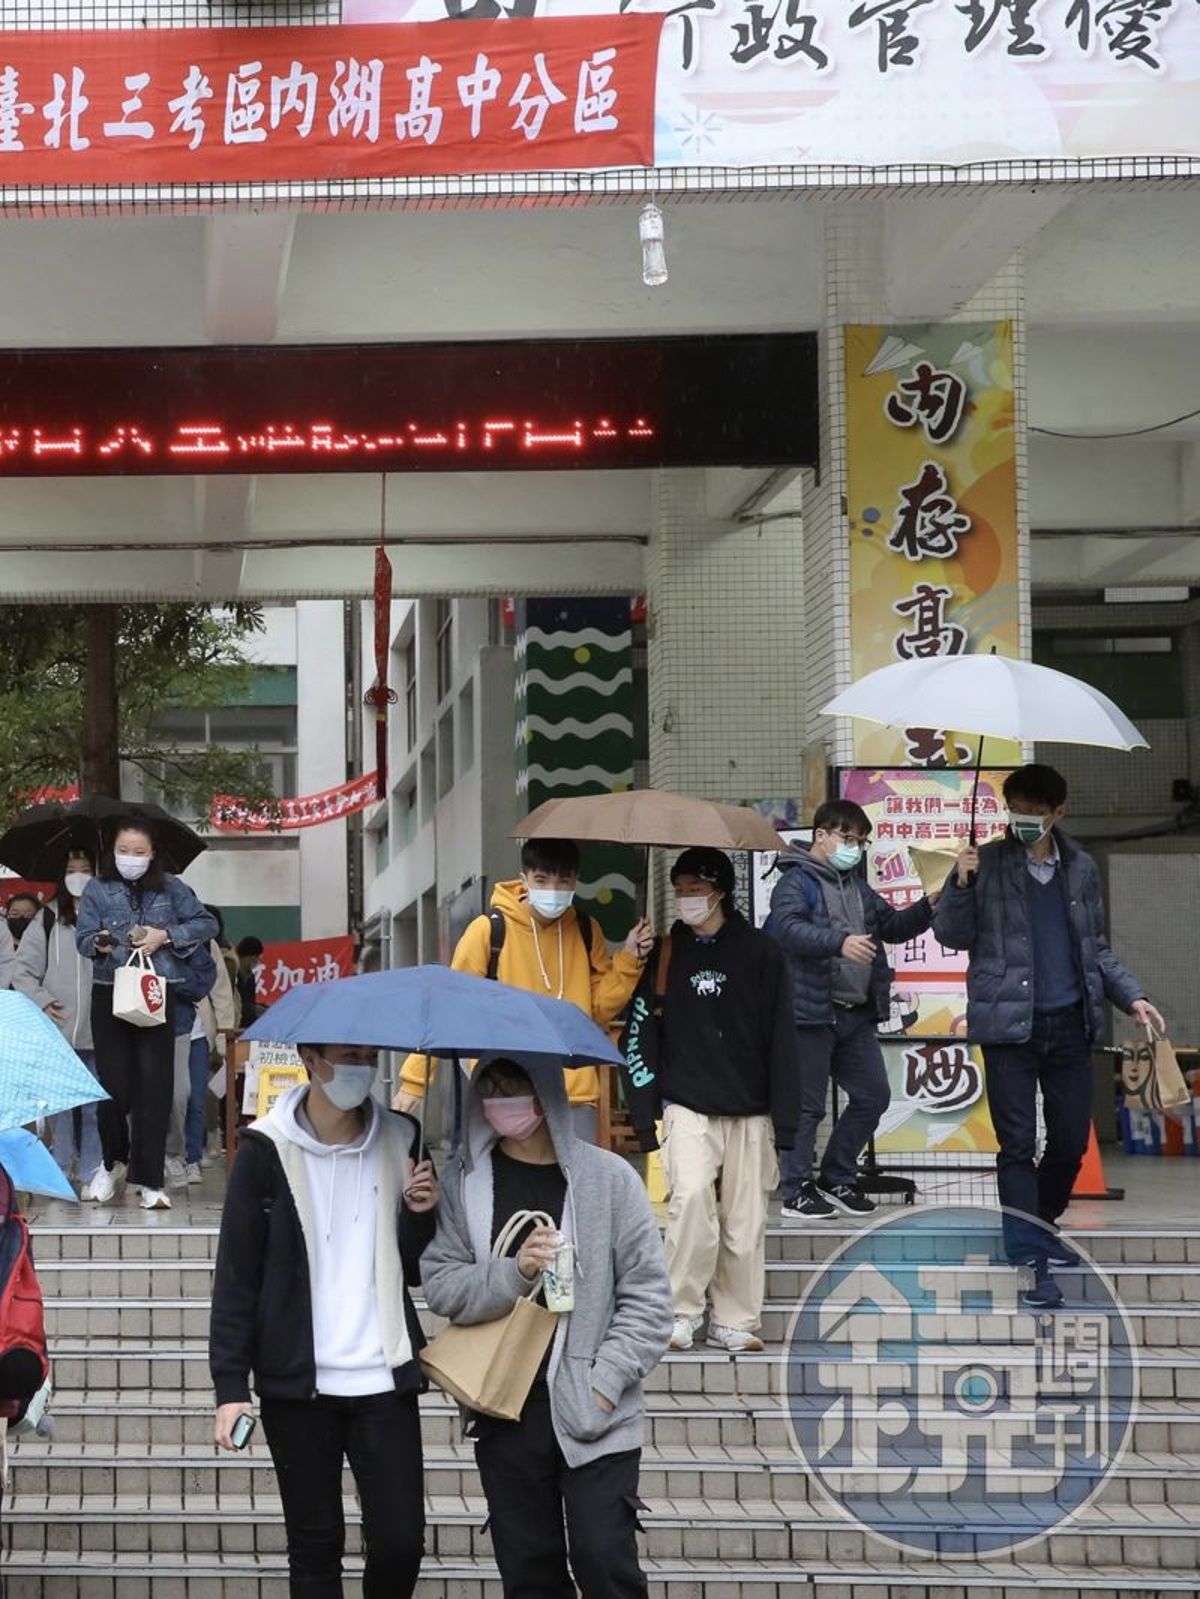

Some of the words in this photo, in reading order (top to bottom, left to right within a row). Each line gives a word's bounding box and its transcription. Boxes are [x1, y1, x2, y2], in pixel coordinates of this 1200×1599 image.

[886, 797, 999, 814] 讓我們一起為
